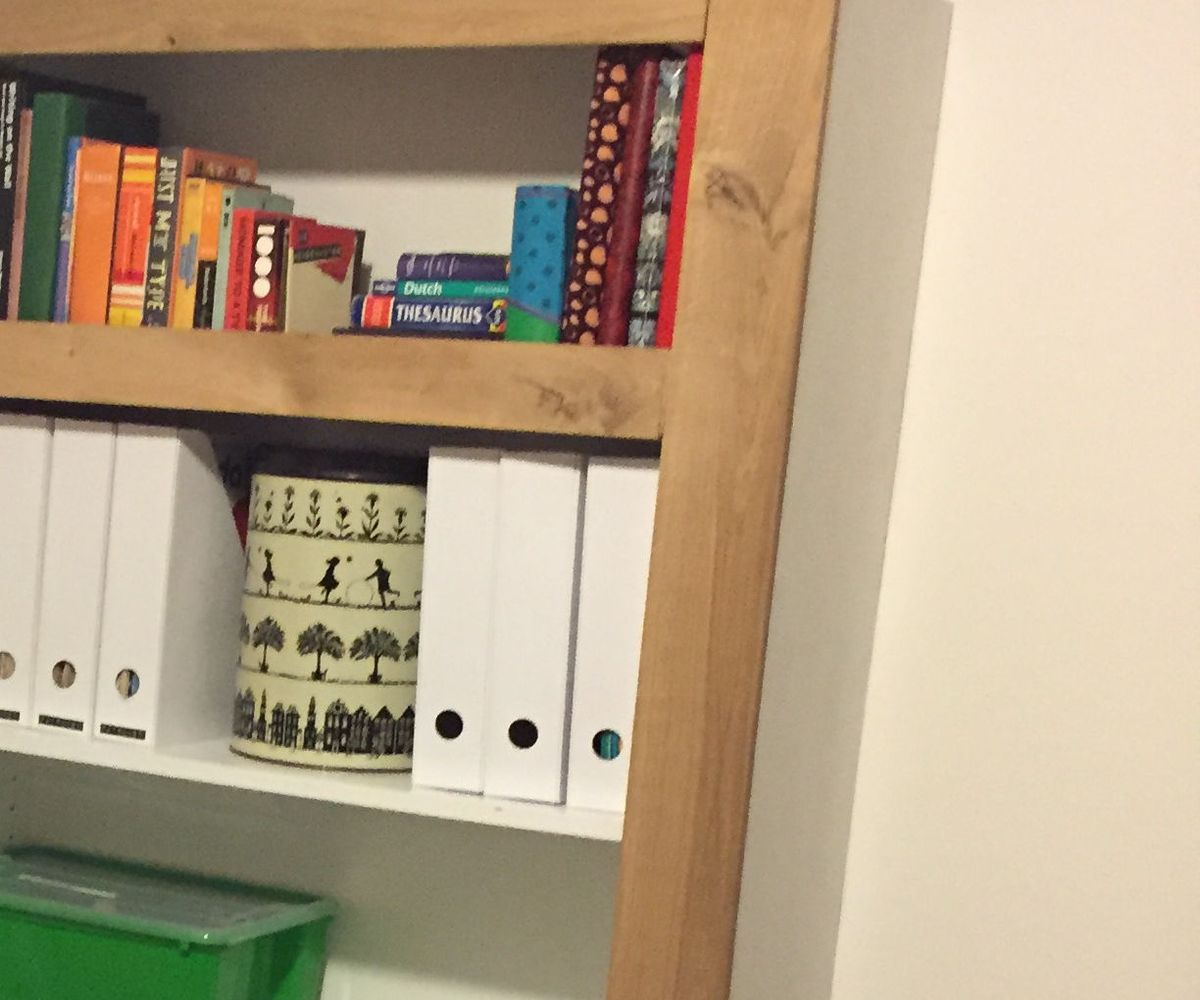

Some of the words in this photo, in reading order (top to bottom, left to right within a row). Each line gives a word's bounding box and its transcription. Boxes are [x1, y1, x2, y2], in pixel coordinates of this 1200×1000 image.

[158, 156, 178, 204] JUST
[252, 223, 276, 299] 1000
[147, 259, 167, 312] TYPE
[403, 281, 444, 297] Dutch
[395, 304, 483, 324] THESAURUS
